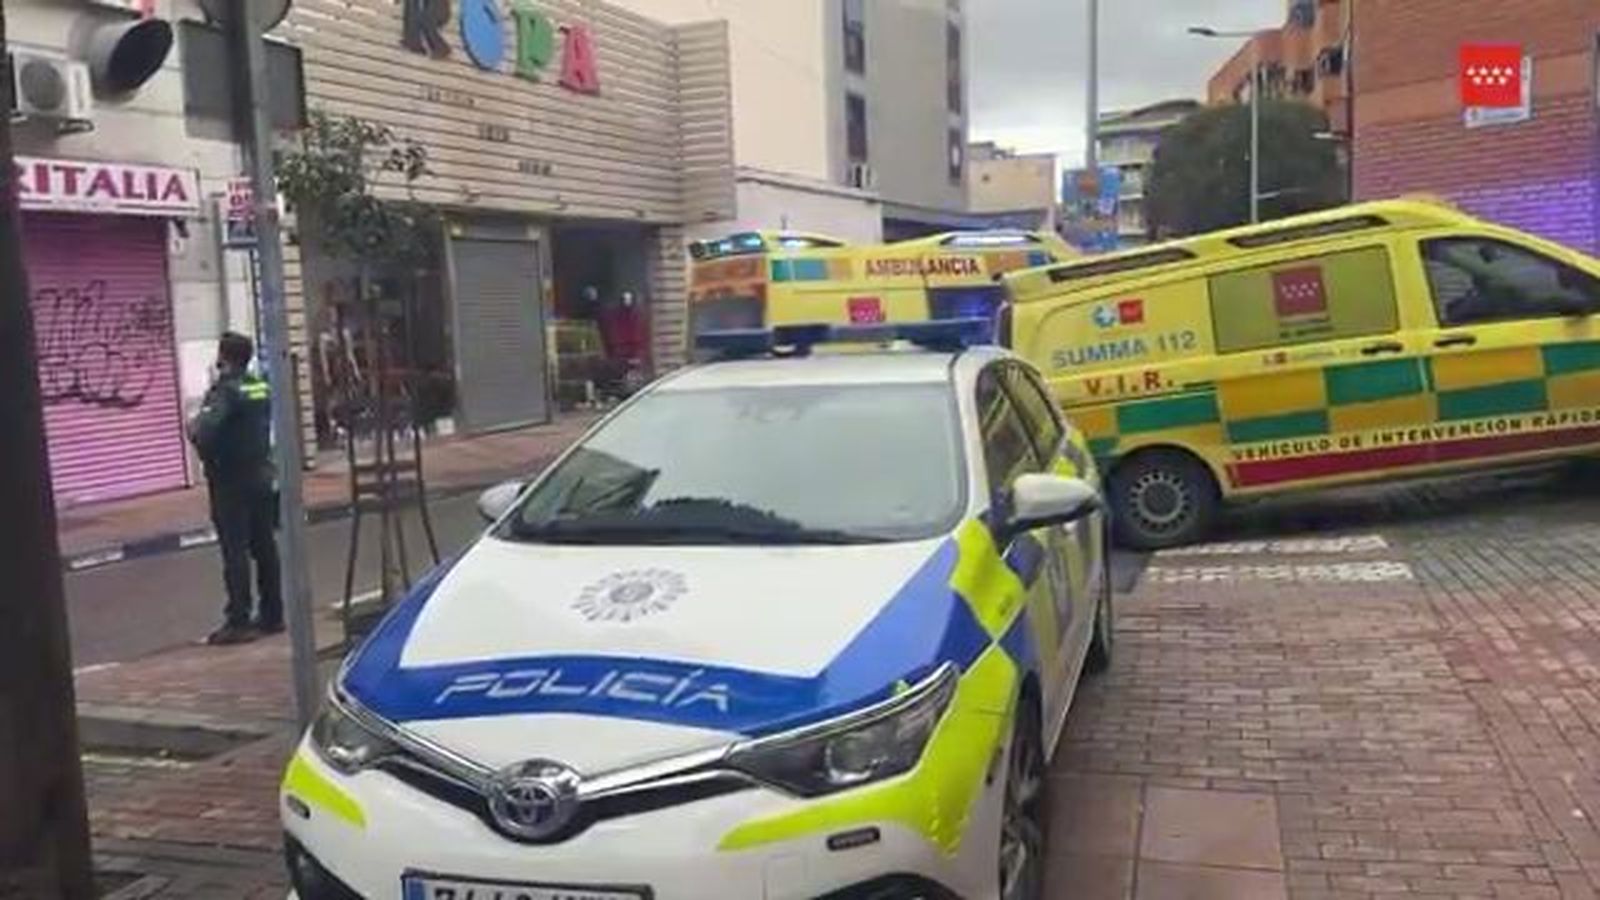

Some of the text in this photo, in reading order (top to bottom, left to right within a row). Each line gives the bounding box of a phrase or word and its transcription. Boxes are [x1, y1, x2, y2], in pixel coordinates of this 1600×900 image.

[398, 0, 600, 96] ROPA
[864, 256, 981, 277] AMBULANCIA
[1052, 329, 1199, 369] SUMMA 112
[1085, 370, 1175, 396] V.I.R.
[1338, 433, 1362, 449] DE
[434, 667, 730, 713] POLICÍA
